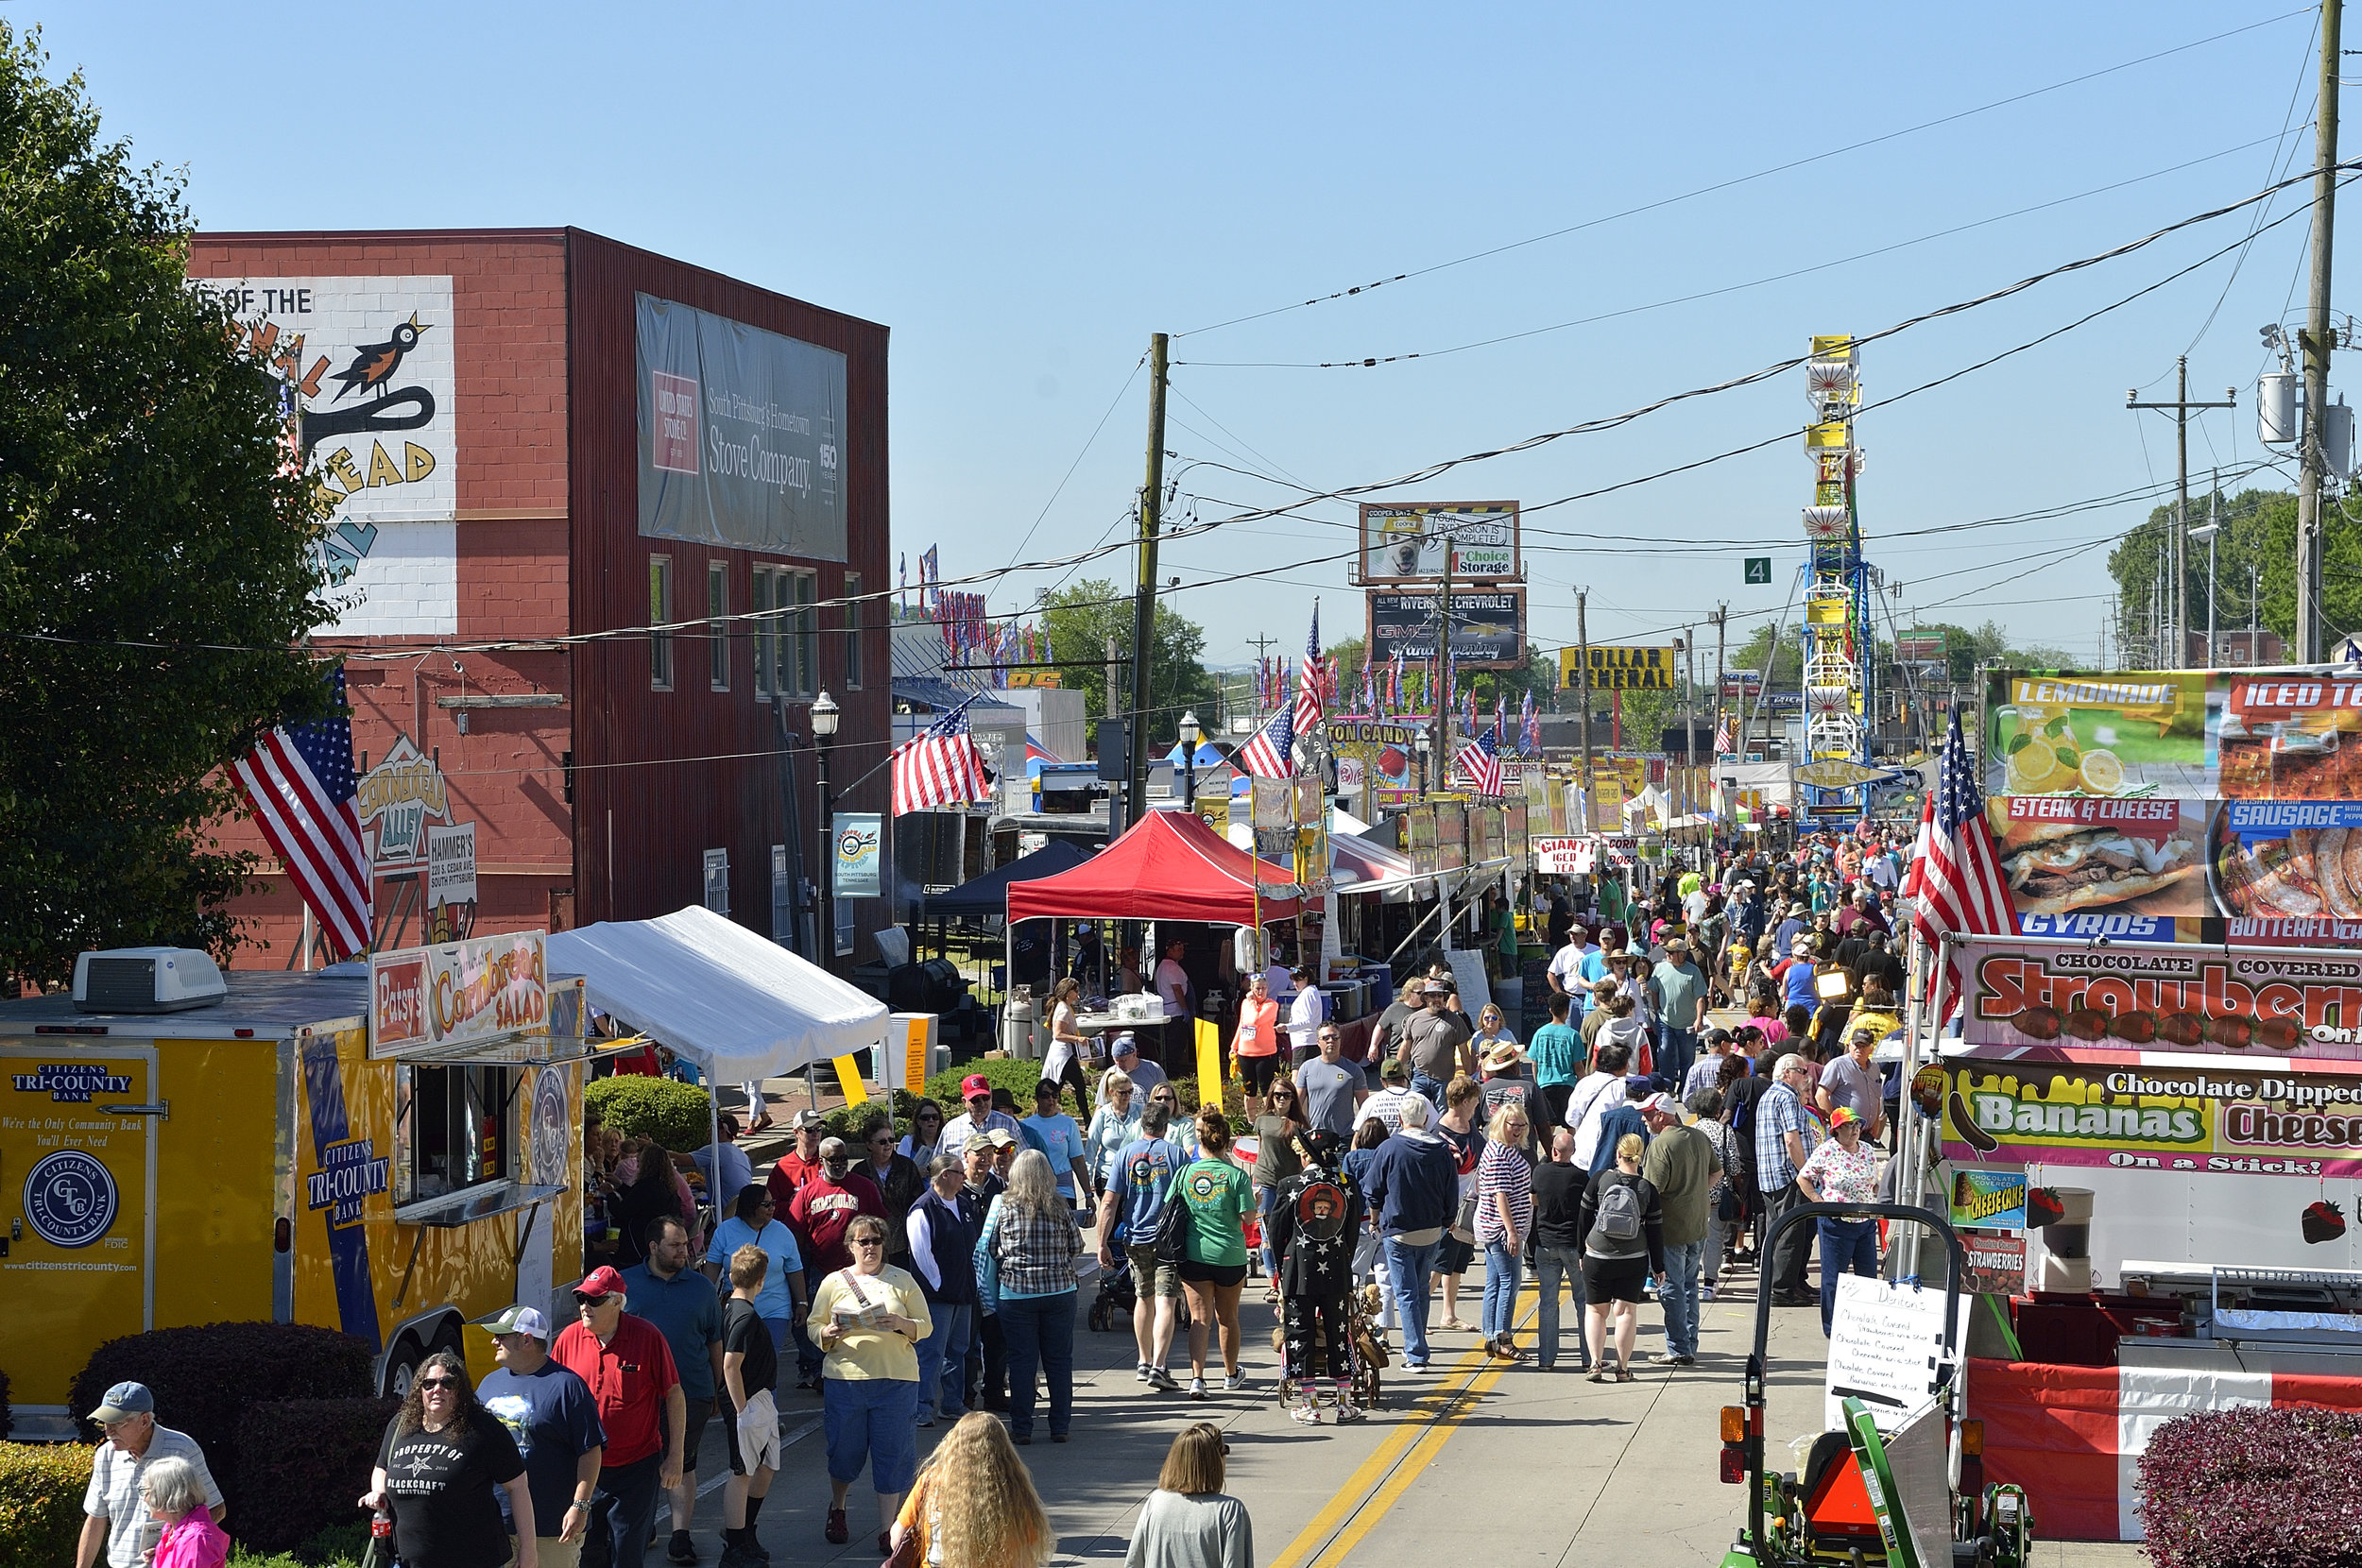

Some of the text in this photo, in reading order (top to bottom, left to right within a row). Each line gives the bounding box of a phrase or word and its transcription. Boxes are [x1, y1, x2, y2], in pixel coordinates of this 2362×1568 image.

[263, 289, 312, 314] THE
[676, 391, 693, 418] STATES
[709, 387, 810, 435] South Pittsburg's Hometown
[710, 425, 811, 499] Stove Company.
[820, 444, 837, 469] 150
[1438, 514, 1456, 522] OUR
[1438, 522, 1499, 534] EXPANSION IS
[1465, 551, 1509, 561] Choice
[1460, 562, 1509, 573] Storage
[1749, 561, 1764, 582] 4
[1455, 595, 1513, 609] CHEVROLET
[1378, 624, 1433, 639] GMC
[1389, 640, 1436, 656] Grand
[1568, 669, 1669, 687] GENERAL
[2018, 682, 2179, 704] LEMONADE
[2244, 683, 2321, 707] ICED
[1909, 701, 1915, 709] 5
[1361, 724, 1415, 745] CANDY
[1798, 761, 1871, 780] ASTRO
[359, 760, 445, 818] CORNBREAD
[1812, 776, 1850, 786] WHEEL
[2011, 799, 2343, 826] STEAK & CHEESE SAUSAGE
[382, 805, 423, 853] ALLEY
[431, 833, 473, 862] HAMMER'S
[1541, 839, 1637, 853] GIANT CORN
[1553, 852, 1637, 864] ICED DOGS
[432, 865, 440, 876] 220
[447, 863, 462, 873] CEDAR
[463, 862, 473, 871] AVE.
[431, 872, 474, 888] SOUTH PITTSBURG
[2022, 913, 2157, 936] GYROS
[2230, 918, 2344, 940] BUTTERFLY
[2055, 953, 2361, 978] CHOCOLATE COVERED
[436, 938, 545, 1033] Cornbread
[379, 971, 421, 1031] Patsy's
[496, 989, 545, 1031] SALAD
[37, 1065, 106, 1074] CITIZENS
[12, 1075, 129, 1090] TRI-COUNTY
[2106, 1072, 2362, 1106] Chocolate Dipped
[53, 1092, 90, 1100] BANK
[3, 1116, 142, 1132] We're the Only Community Bank
[1976, 1097, 2199, 1138] Bananas
[38, 1134, 107, 1147] You'll Ever Need
[325, 1140, 372, 1165] CITIZENS
[44, 1160, 98, 1181] CITIZENS
[2108, 1152, 2321, 1175] On a Stick!
[308, 1159, 388, 1205] TRI-COUNTY
[88, 1194, 106, 1227] BANK
[335, 1201, 362, 1220] BANK
[1974, 1238, 2019, 1251] Chocolate Covered
[4, 1261, 137, 1272] www.citizenstricounty.com
[1968, 1251, 2024, 1271] STRAWBERRIES
[1875, 1339, 1904, 1352] Covered
[1867, 1368, 1893, 1378] Covered
[394, 1443, 464, 1461] PROPERTY OF
[387, 1478, 446, 1491] BLACKCRAFT
